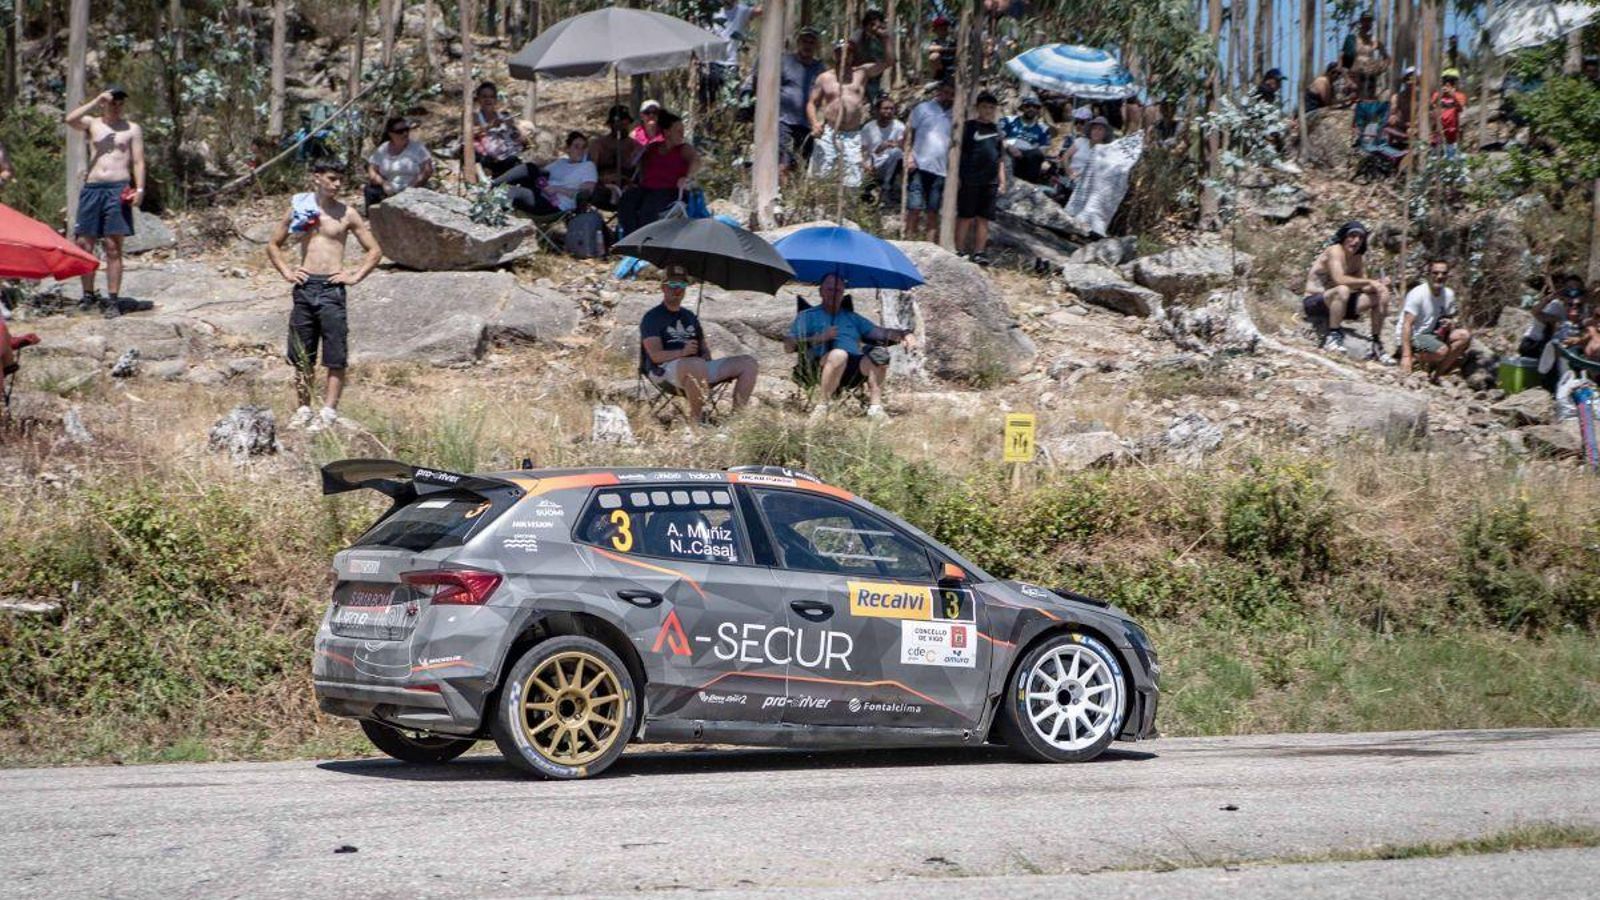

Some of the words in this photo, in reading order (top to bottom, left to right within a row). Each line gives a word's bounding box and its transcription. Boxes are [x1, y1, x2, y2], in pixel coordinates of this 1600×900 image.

[611, 509, 633, 552] 3
[667, 522, 683, 537] A.
[687, 522, 733, 541] Muñiz
[857, 589, 925, 611] Recalvi
[945, 591, 961, 620] 3
[914, 628, 948, 636] CONCELLO
[943, 656, 970, 664] amura
[863, 702, 922, 713] Fontalclima
